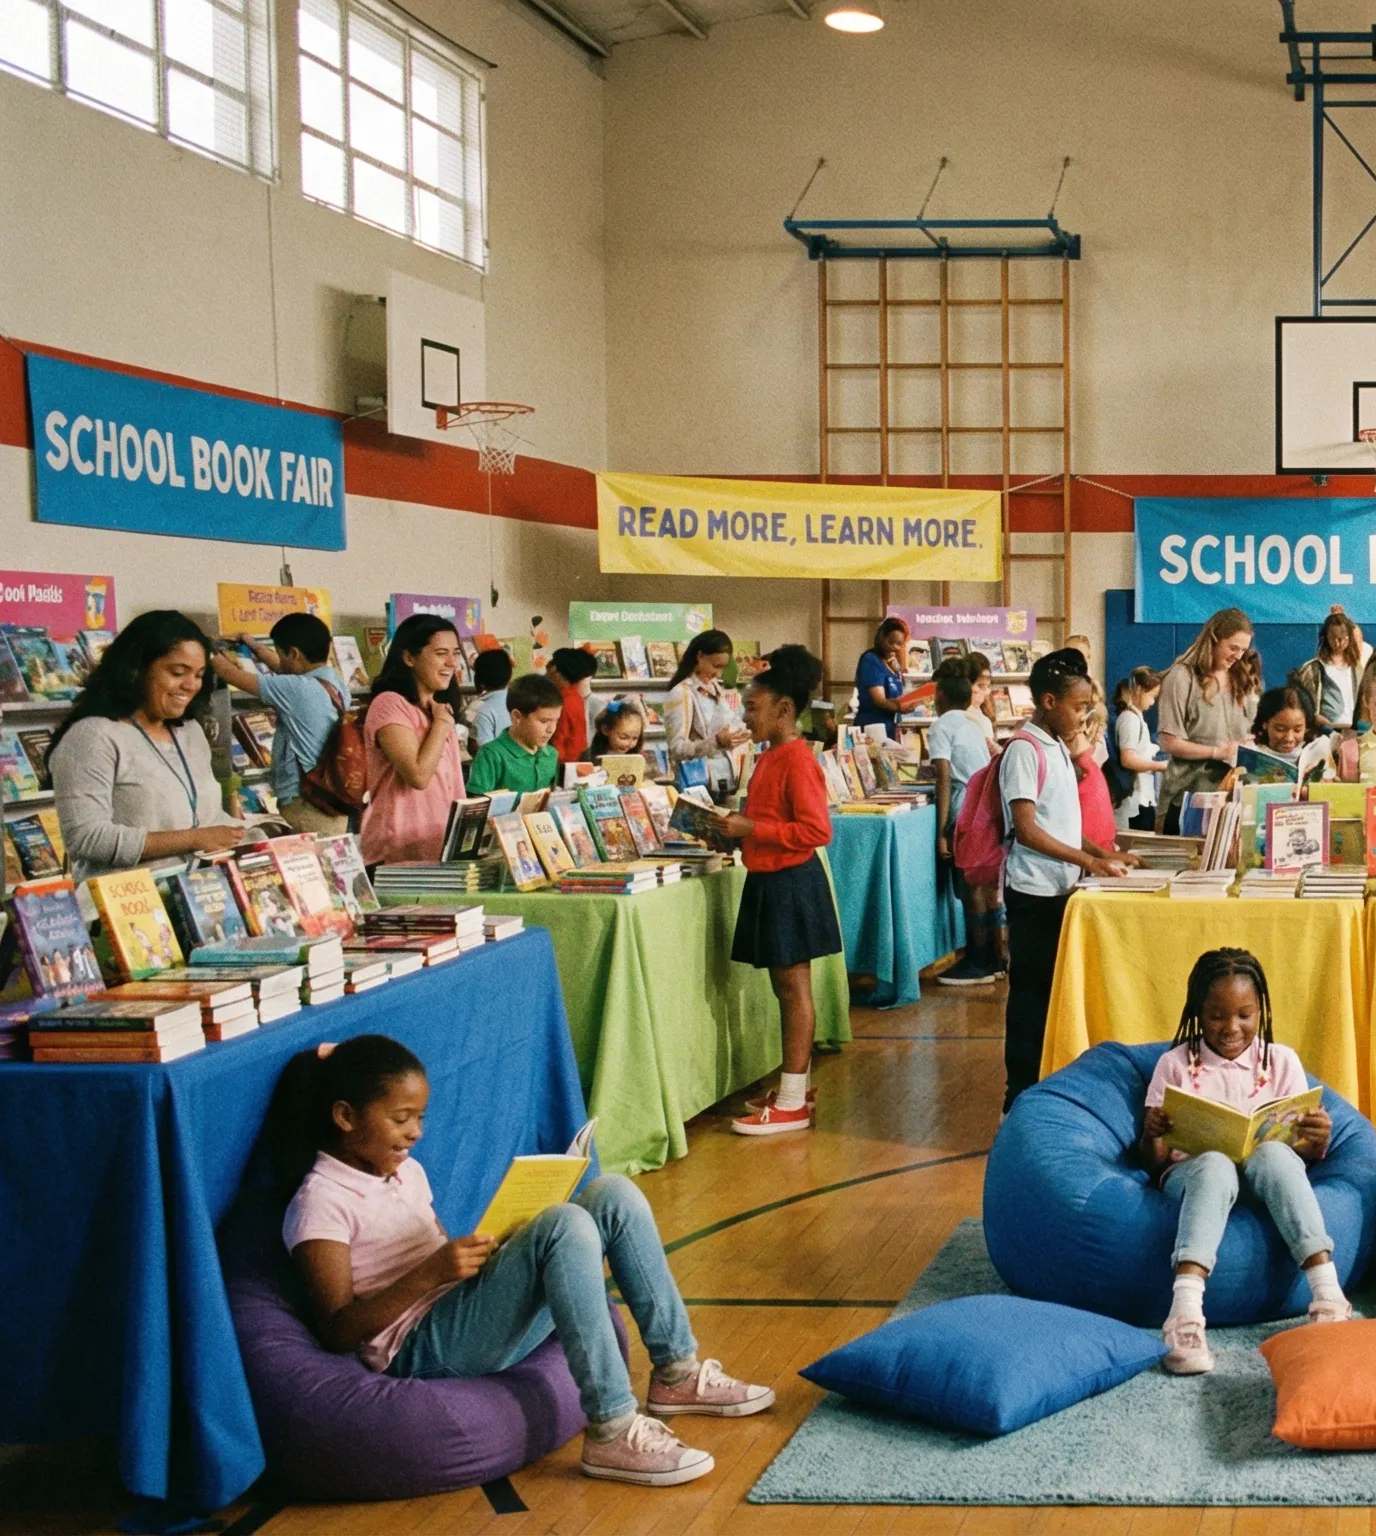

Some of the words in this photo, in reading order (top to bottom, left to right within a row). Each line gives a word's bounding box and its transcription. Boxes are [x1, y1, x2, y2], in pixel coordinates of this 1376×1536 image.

[45, 410, 186, 488] SCHOOL
[191, 435, 274, 500] BOOK
[280, 451, 334, 508] FAIR
[618, 505, 699, 541] READ
[707, 509, 797, 549] MORE,
[805, 514, 894, 546] LEARN
[903, 518, 984, 549] MORE.
[1159, 534, 1354, 585] SCHOOL
